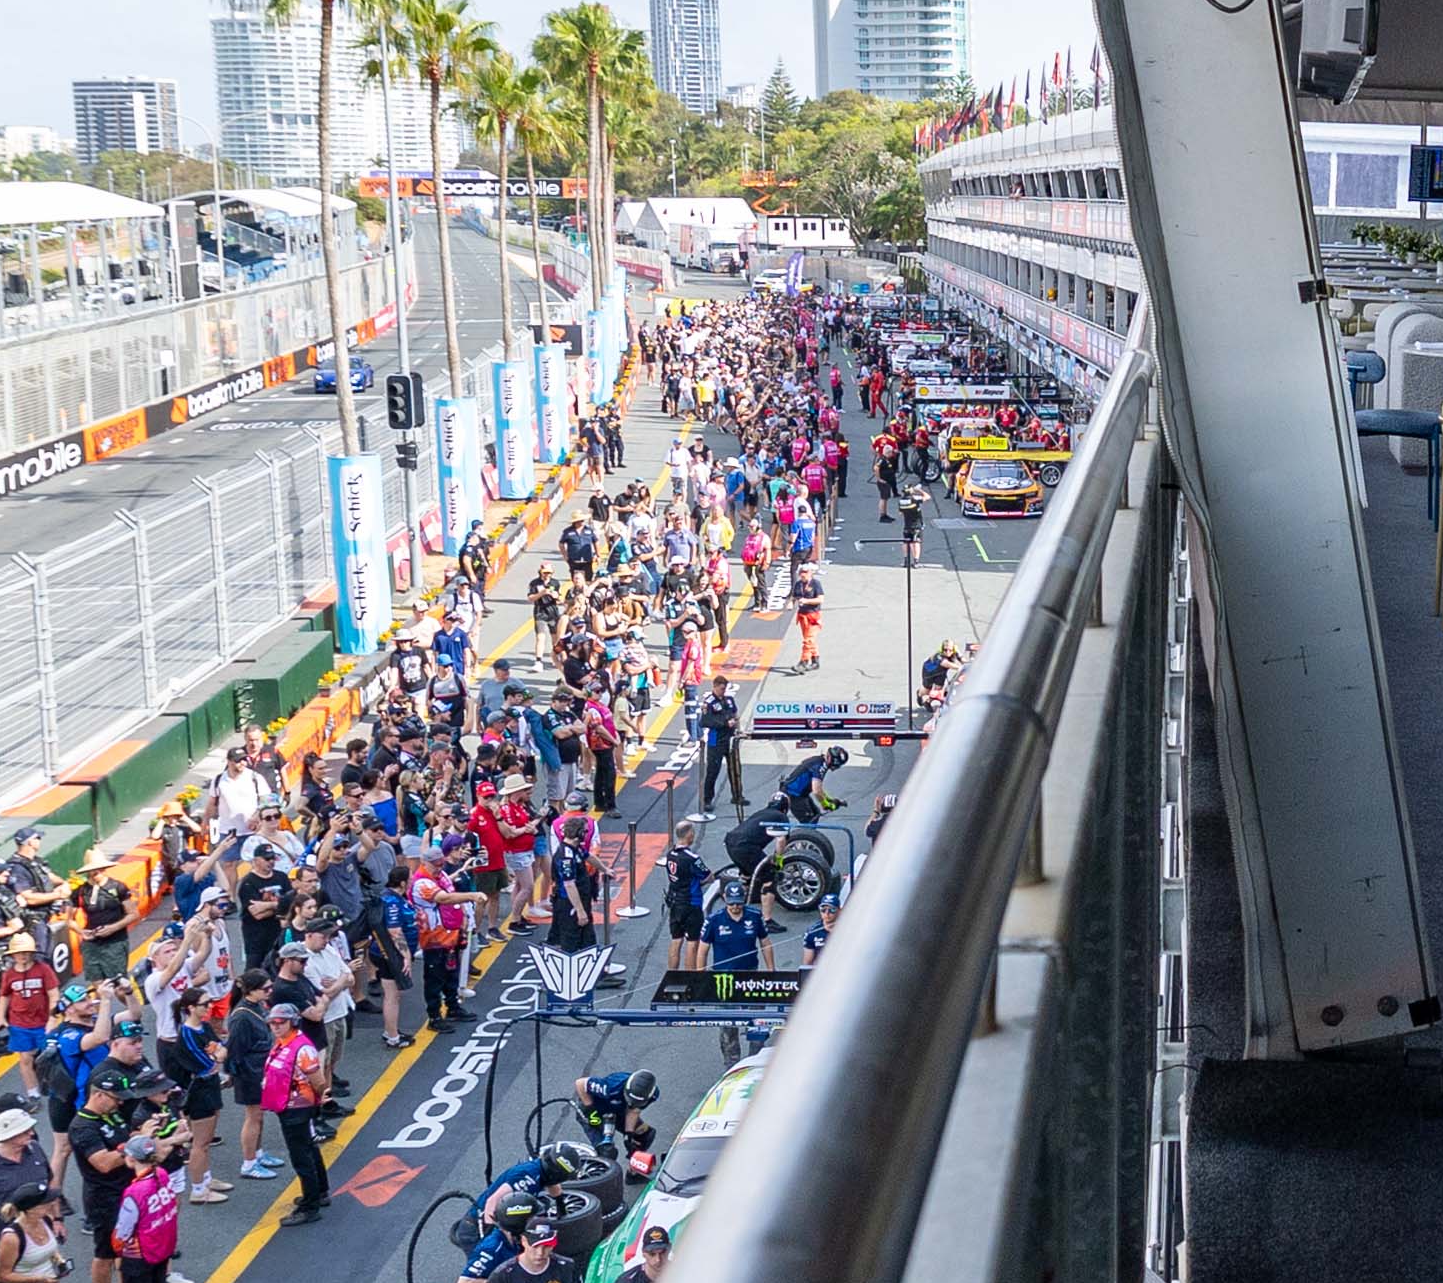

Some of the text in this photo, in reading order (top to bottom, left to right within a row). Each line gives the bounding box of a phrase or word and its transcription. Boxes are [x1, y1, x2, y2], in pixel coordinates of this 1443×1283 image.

[187, 369, 264, 417] boostmobile
[505, 373, 515, 415] Schick
[444, 411, 456, 460] Schick
[347, 473, 363, 534] Schick
[448, 484, 459, 532] Schick
[352, 562, 368, 622] Schick
[756, 703, 800, 715] OPTUS
[805, 703, 836, 715] Mobil
[734, 978, 799, 992] MONSTER
